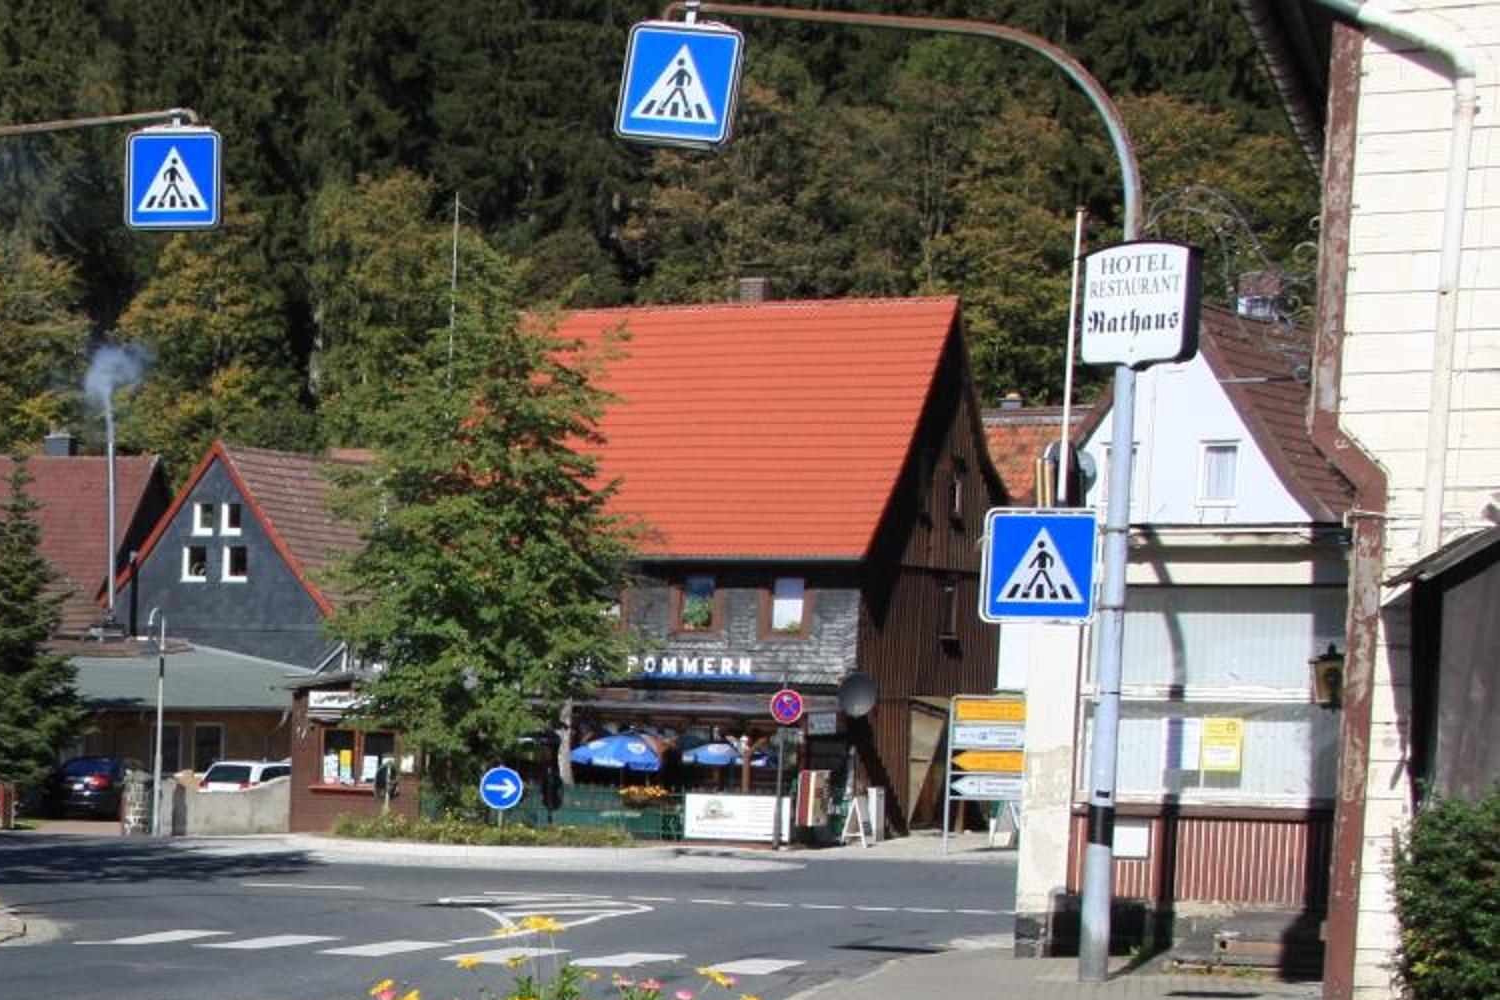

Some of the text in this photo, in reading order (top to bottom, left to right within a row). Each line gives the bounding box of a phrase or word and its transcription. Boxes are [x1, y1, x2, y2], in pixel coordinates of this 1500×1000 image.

[1100, 253, 1174, 275] HOTEL
[1089, 274, 1181, 299] RESTAURANT
[1087, 308, 1180, 337] Rathaus
[627, 656, 752, 675] POMMERN
